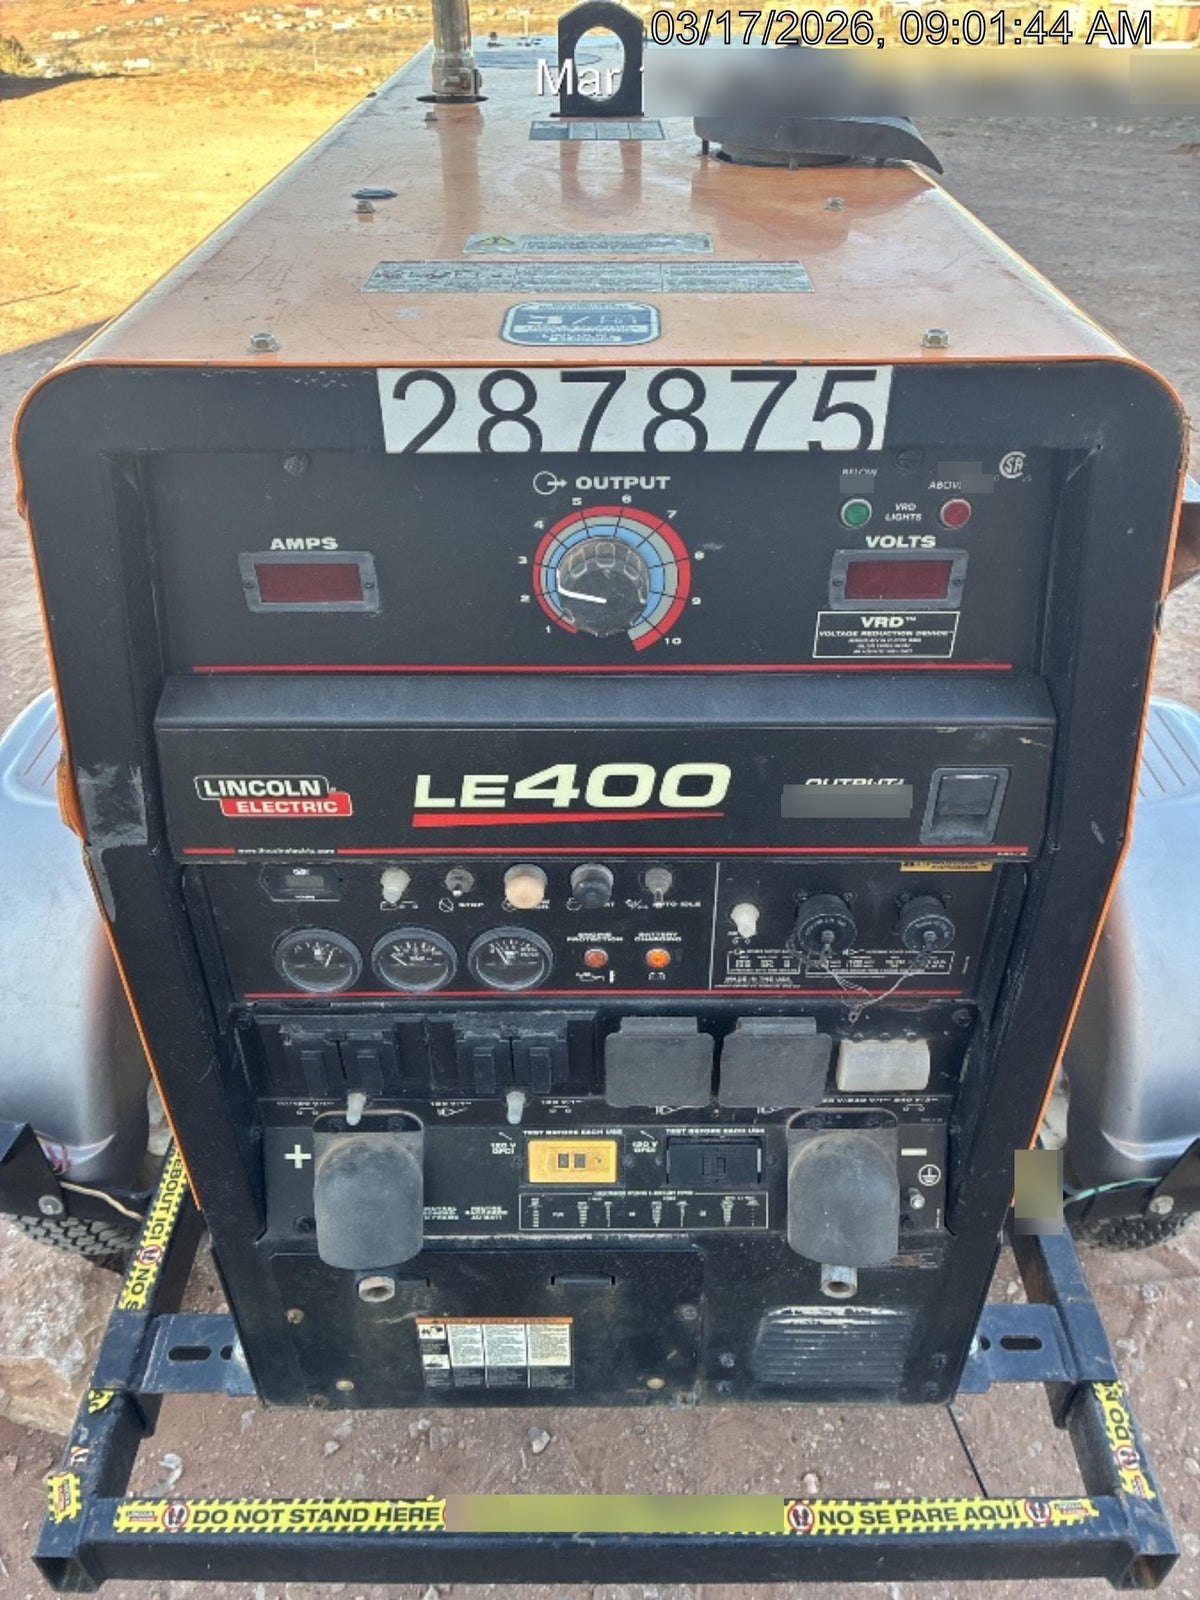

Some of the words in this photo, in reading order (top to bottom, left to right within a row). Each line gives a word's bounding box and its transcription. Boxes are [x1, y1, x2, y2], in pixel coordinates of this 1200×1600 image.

[392, 368, 875, 453] 287875
[575, 476, 671, 490] OUTPUT
[928, 481, 962, 490] ABOV
[572, 497, 582, 505] 5
[621, 494, 632, 503] 6
[895, 503, 917, 511] VRD
[667, 510, 678, 519] 7
[885, 514, 922, 522] LIGHTS
[533, 520, 544, 529] 4
[269, 537, 339, 550] AMPS
[865, 535, 937, 548] VOLTS
[691, 597, 702, 605] 9
[545, 625, 551, 634] 1
[664, 637, 682, 645] 10
[204, 780, 321, 796] LINCOLN
[413, 763, 732, 808] LE400
[235, 801, 339, 813] ELECTRIC
[157, 1157, 183, 1214] EBOUT
[131, 1267, 150, 1296] NO
[1109, 1407, 1130, 1441] DO
[192, 1510, 228, 1525] DO
[234, 1509, 284, 1524] NOT
[289, 1507, 369, 1523] STAND
[375, 1506, 440, 1522] HERE
[818, 1510, 855, 1526] NO
[859, 1509, 889, 1524] SE
[896, 1507, 959, 1523] PARE
